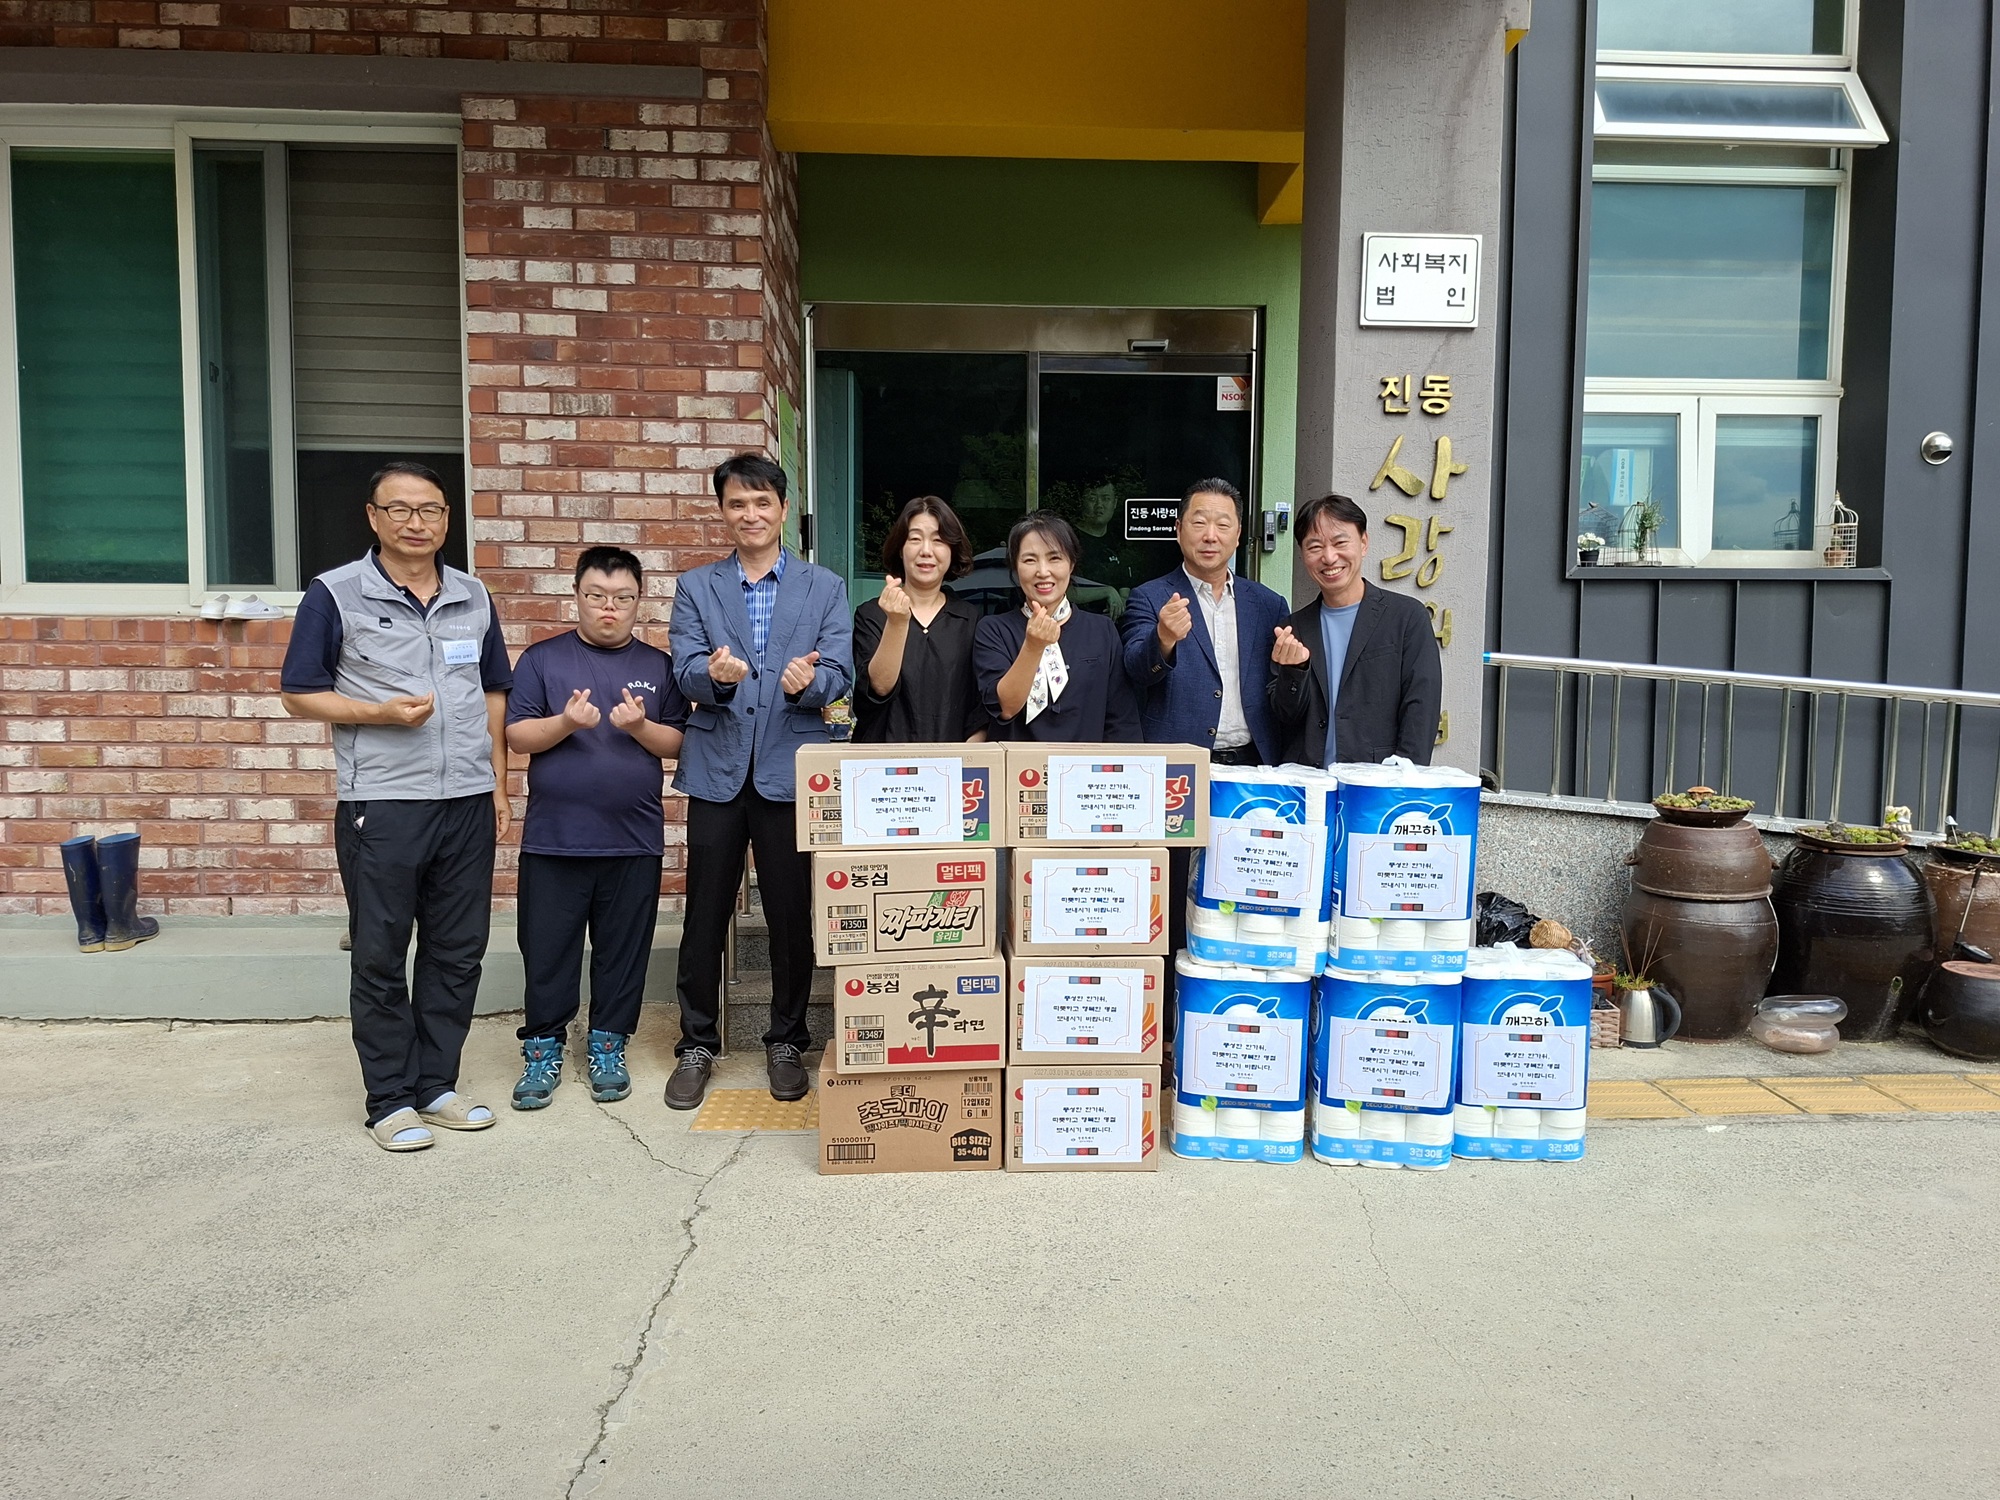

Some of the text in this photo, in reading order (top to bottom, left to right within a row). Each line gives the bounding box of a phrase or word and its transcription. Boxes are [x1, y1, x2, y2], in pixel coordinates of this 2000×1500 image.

[1378, 252, 1467, 274] 사회복지
[1378, 374, 1454, 415] 진동
[1130, 508, 1178, 519] 진동 사랑의
[941, 864, 982, 880] 멀티팩
[850, 872, 888, 888] 농심
[842, 920, 866, 928] 가3501
[879, 905, 980, 941] 짜파게티
[936, 931, 960, 942] 올리브
[866, 980, 899, 994] 농심
[961, 978, 996, 991] 멀티팩
[908, 984, 985, 1057] 辛 라면
[859, 1030, 883, 1038] 가3487
[890, 1085, 916, 1097] 롯데
[857, 1097, 950, 1125] 초코파이
[967, 1109, 972, 1117] 6
[951, 1135, 991, 1147] BIG SIZE!
